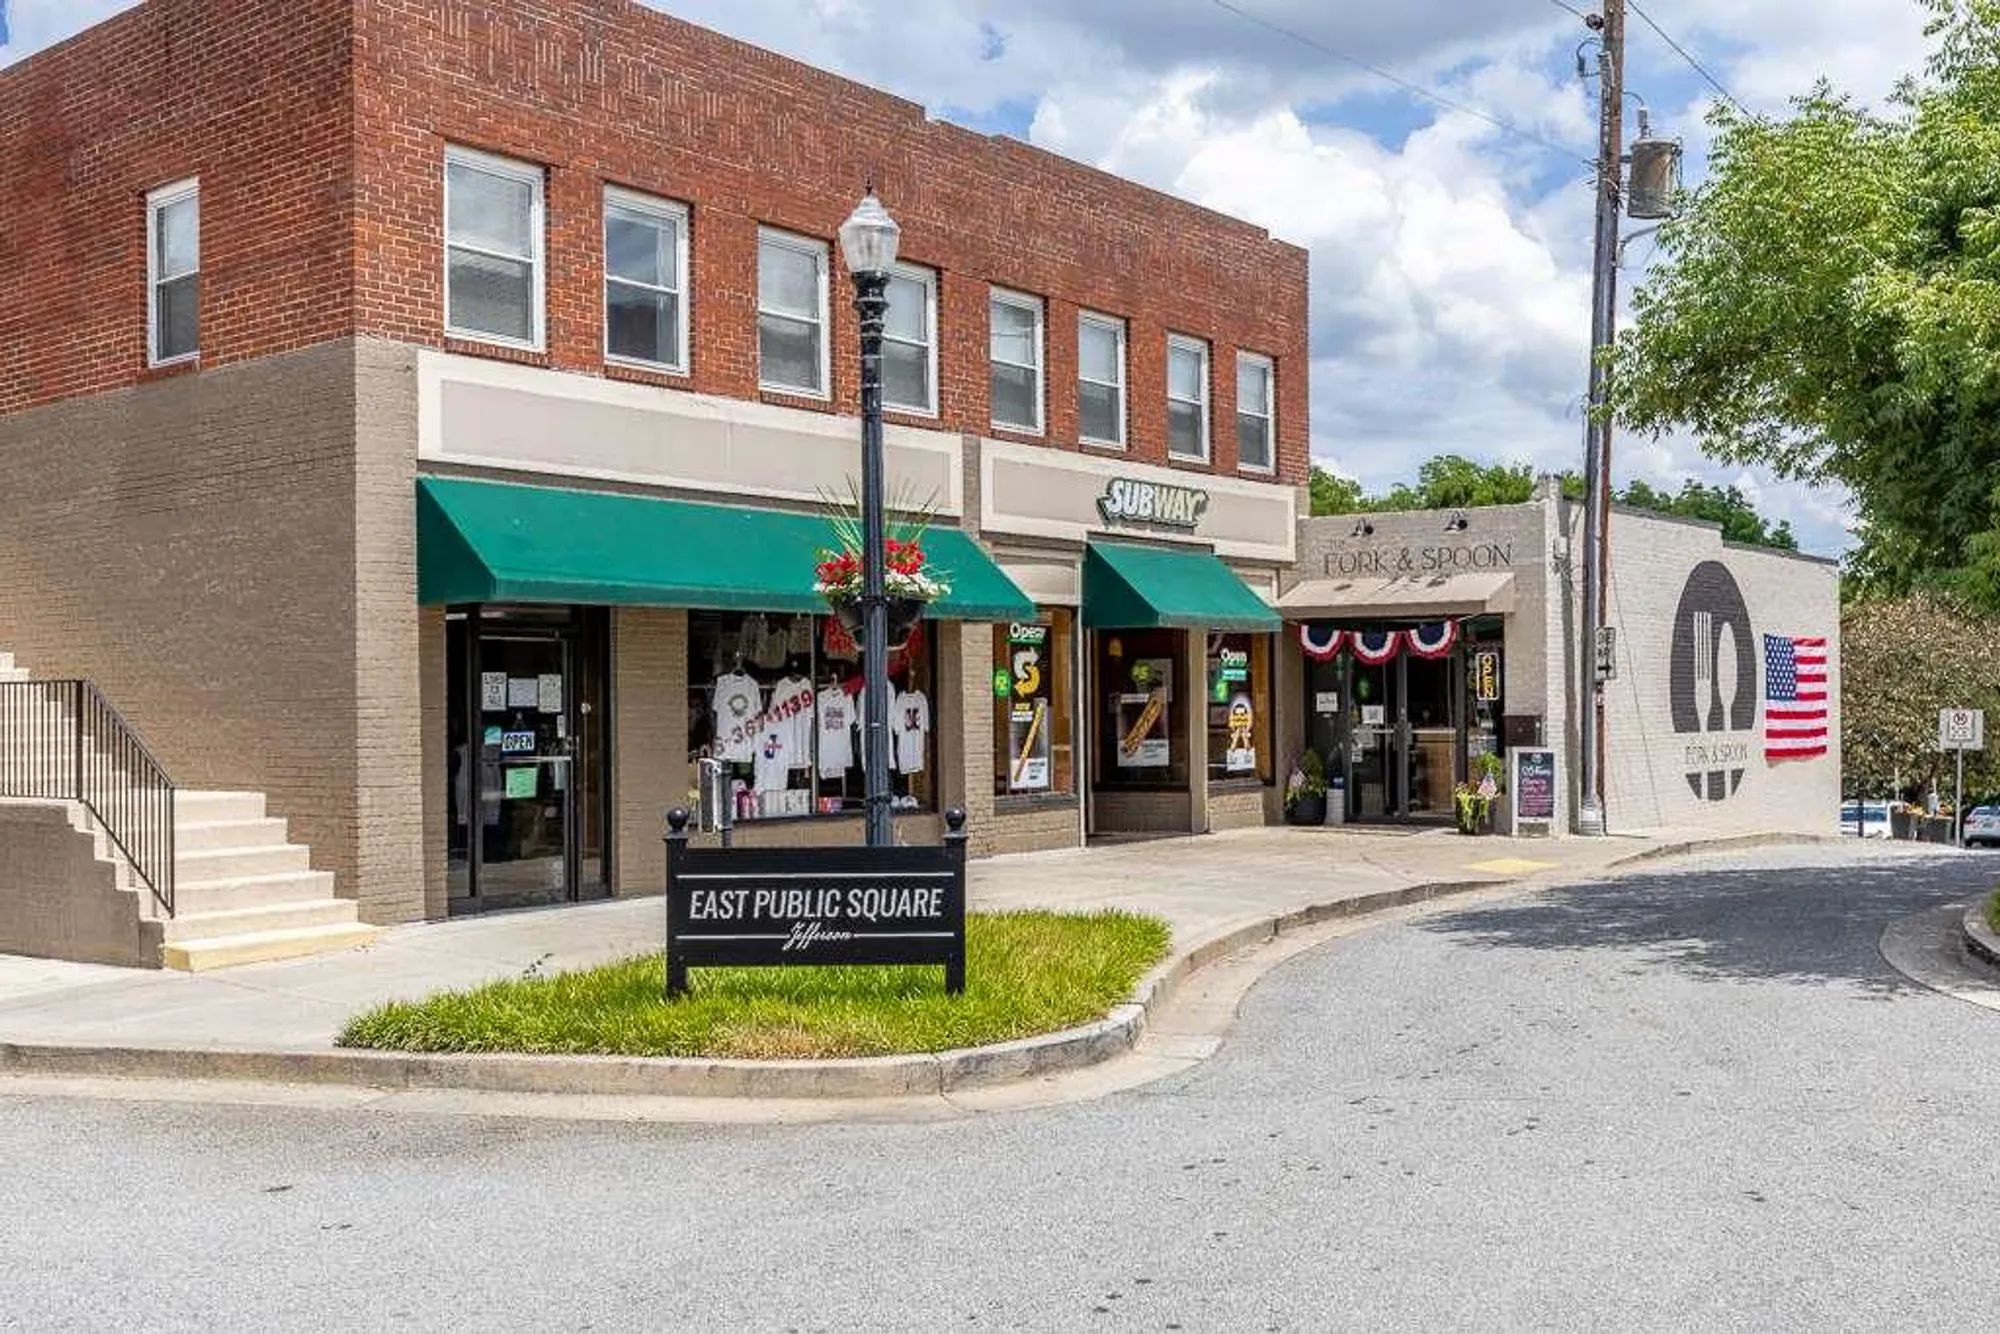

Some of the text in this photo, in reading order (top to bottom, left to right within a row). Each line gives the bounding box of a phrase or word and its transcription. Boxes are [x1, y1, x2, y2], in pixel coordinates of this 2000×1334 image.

[1104, 479, 1207, 522] SUBWAY
[1324, 543, 1512, 576] FORK & SPOON
[1010, 622, 1046, 640] Open
[1483, 655, 1493, 698] OPEN
[503, 734, 533, 750] OPEN
[689, 888, 944, 922] EAST PUBLIC SQUARE
[782, 921, 852, 951] Jefferson
